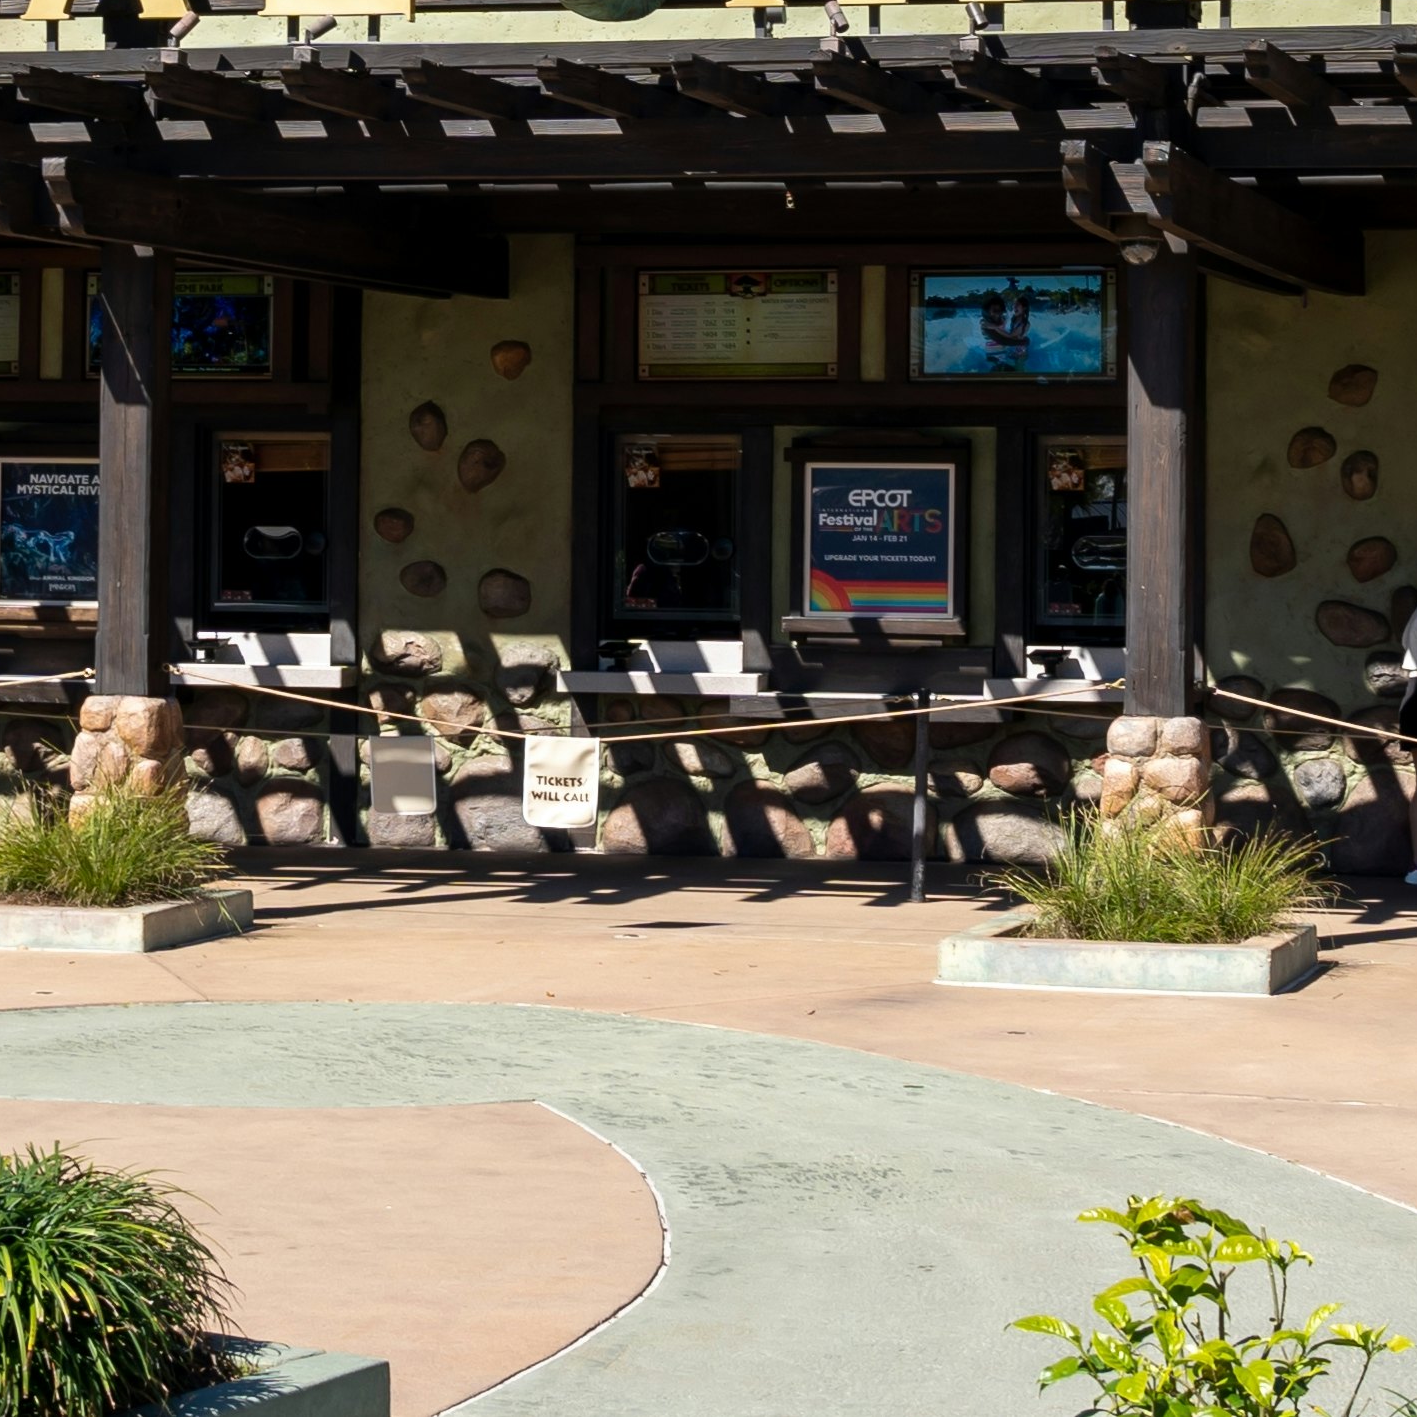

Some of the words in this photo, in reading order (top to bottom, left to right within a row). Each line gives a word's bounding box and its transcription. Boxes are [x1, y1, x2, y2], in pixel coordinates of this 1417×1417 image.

[29, 474, 89, 485] NAVIGATE
[16, 484, 76, 495] MYSTICAL
[78, 486, 100, 495] RIV
[848, 489, 913, 507] EPCOT
[818, 508, 878, 526] Festival
[875, 508, 943, 534] ARTS
[824, 554, 857, 562] UPGRADE
[858, 554, 879, 562] YOUR
[531, 790, 560, 802] WILL
[563, 792, 590, 802] CALL
